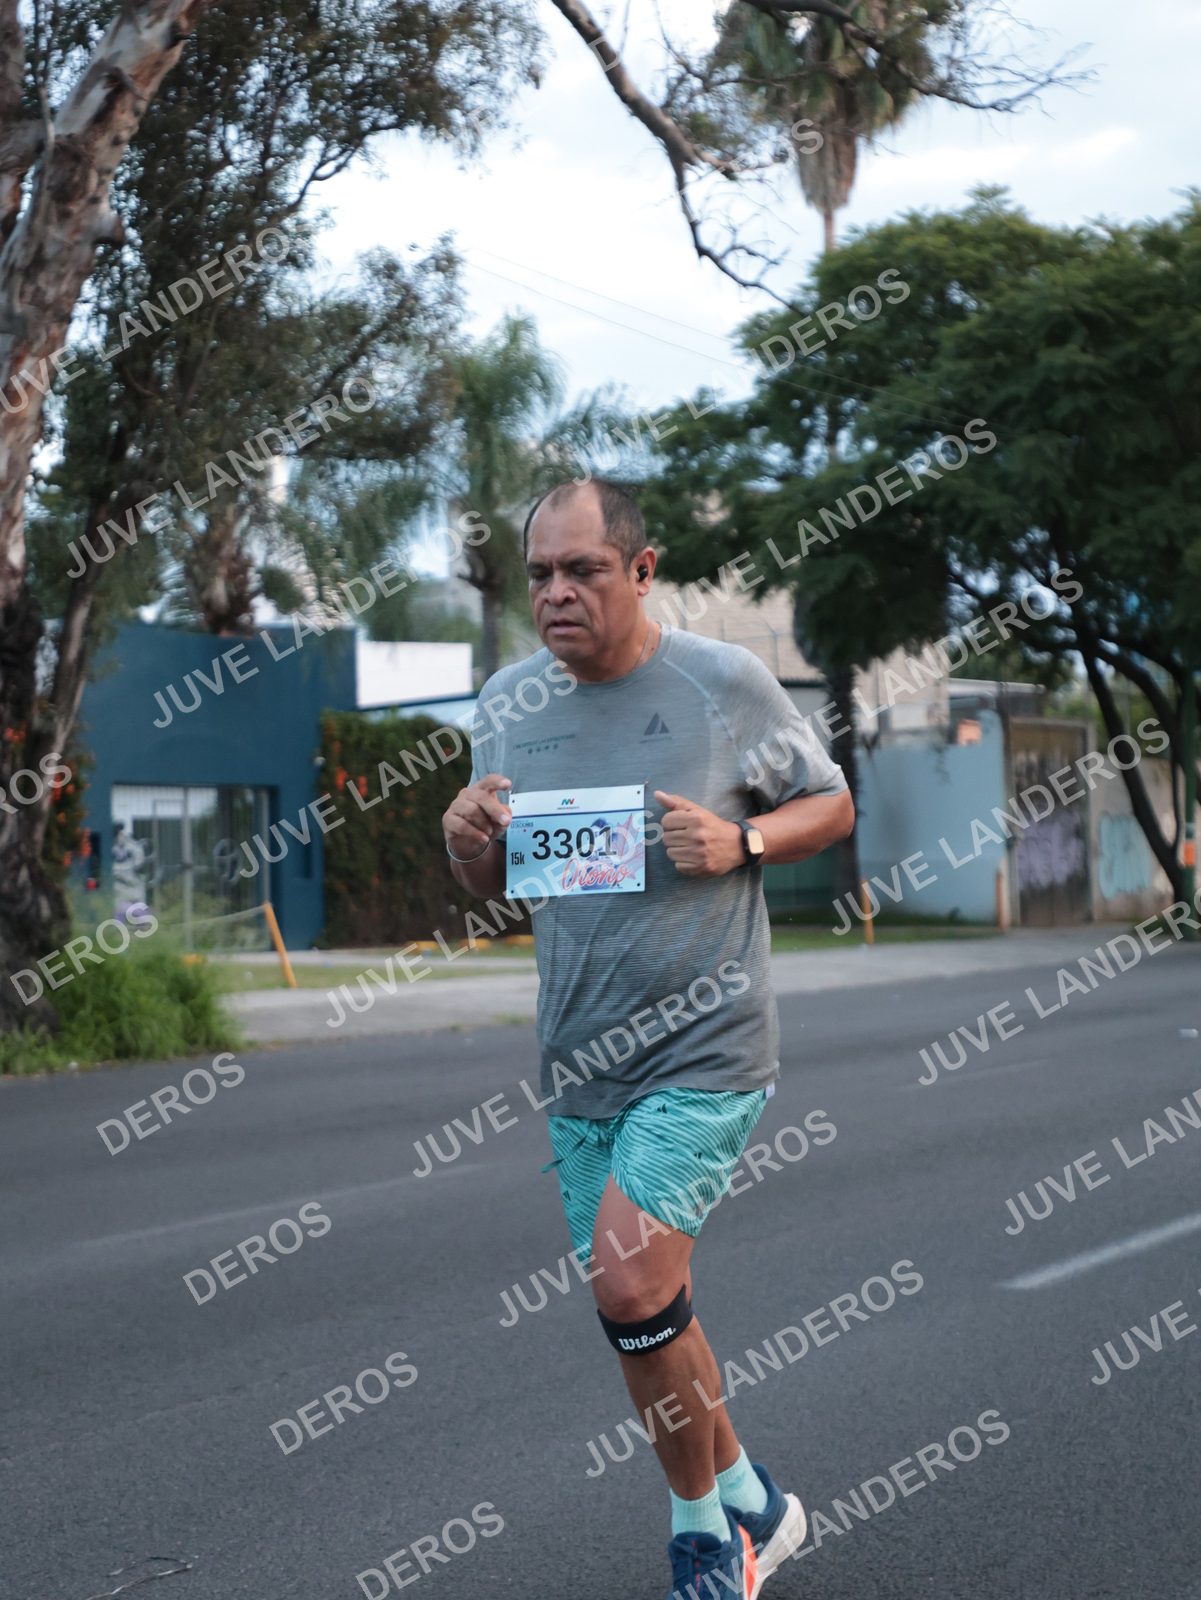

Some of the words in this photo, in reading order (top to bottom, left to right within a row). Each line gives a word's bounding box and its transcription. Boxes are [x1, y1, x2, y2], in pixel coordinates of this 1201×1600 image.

[532, 826, 617, 860] 3301
[510, 852, 525, 866] 15k
[619, 1326, 674, 1350] Wilson
